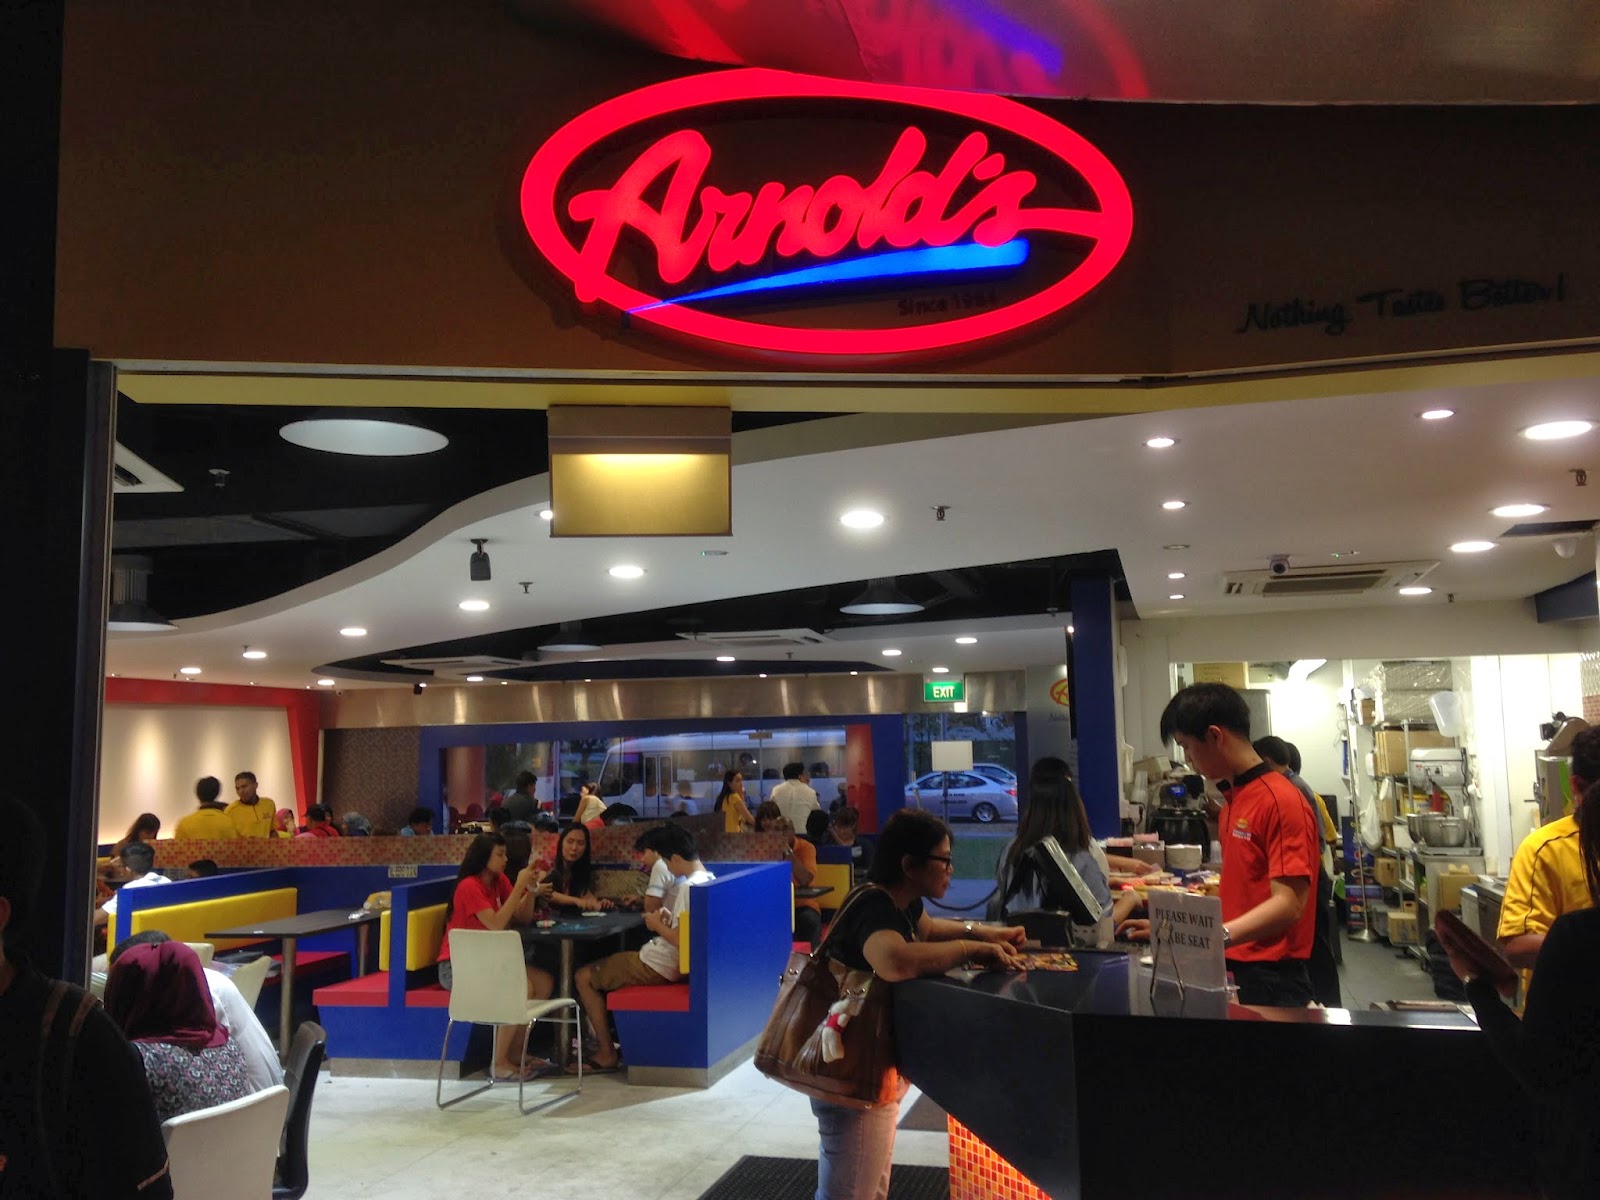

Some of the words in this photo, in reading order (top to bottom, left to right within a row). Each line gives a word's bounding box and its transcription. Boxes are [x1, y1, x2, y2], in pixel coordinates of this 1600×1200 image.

[568, 125, 1040, 304] Arnold's
[897, 297, 948, 316] Since
[1234, 297, 1353, 336] Nothing
[932, 685, 955, 699] EXIT
[1155, 907, 1188, 925] PLEASE
[1188, 912, 1215, 929] WAIT
[1174, 931, 1186, 945] BE
[1187, 934, 1212, 950] SEAT
